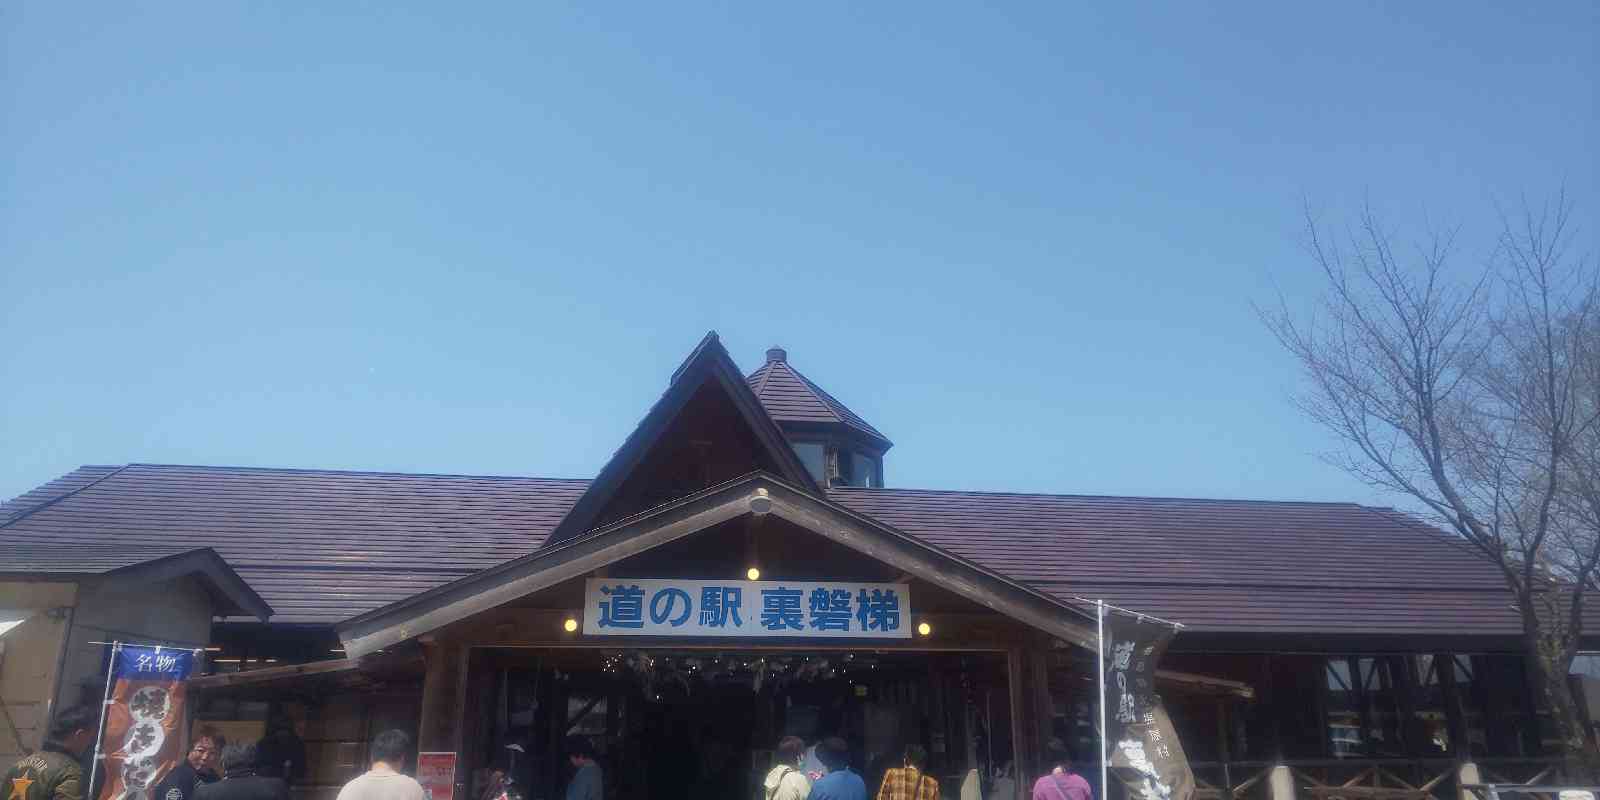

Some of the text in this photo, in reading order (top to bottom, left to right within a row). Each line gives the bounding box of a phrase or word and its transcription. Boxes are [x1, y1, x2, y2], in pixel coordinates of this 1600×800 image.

[598, 584, 900, 632] 道の駅 裏磐梯
[135, 653, 177, 673] 名物
[122, 687, 170, 800] 焼きだ
